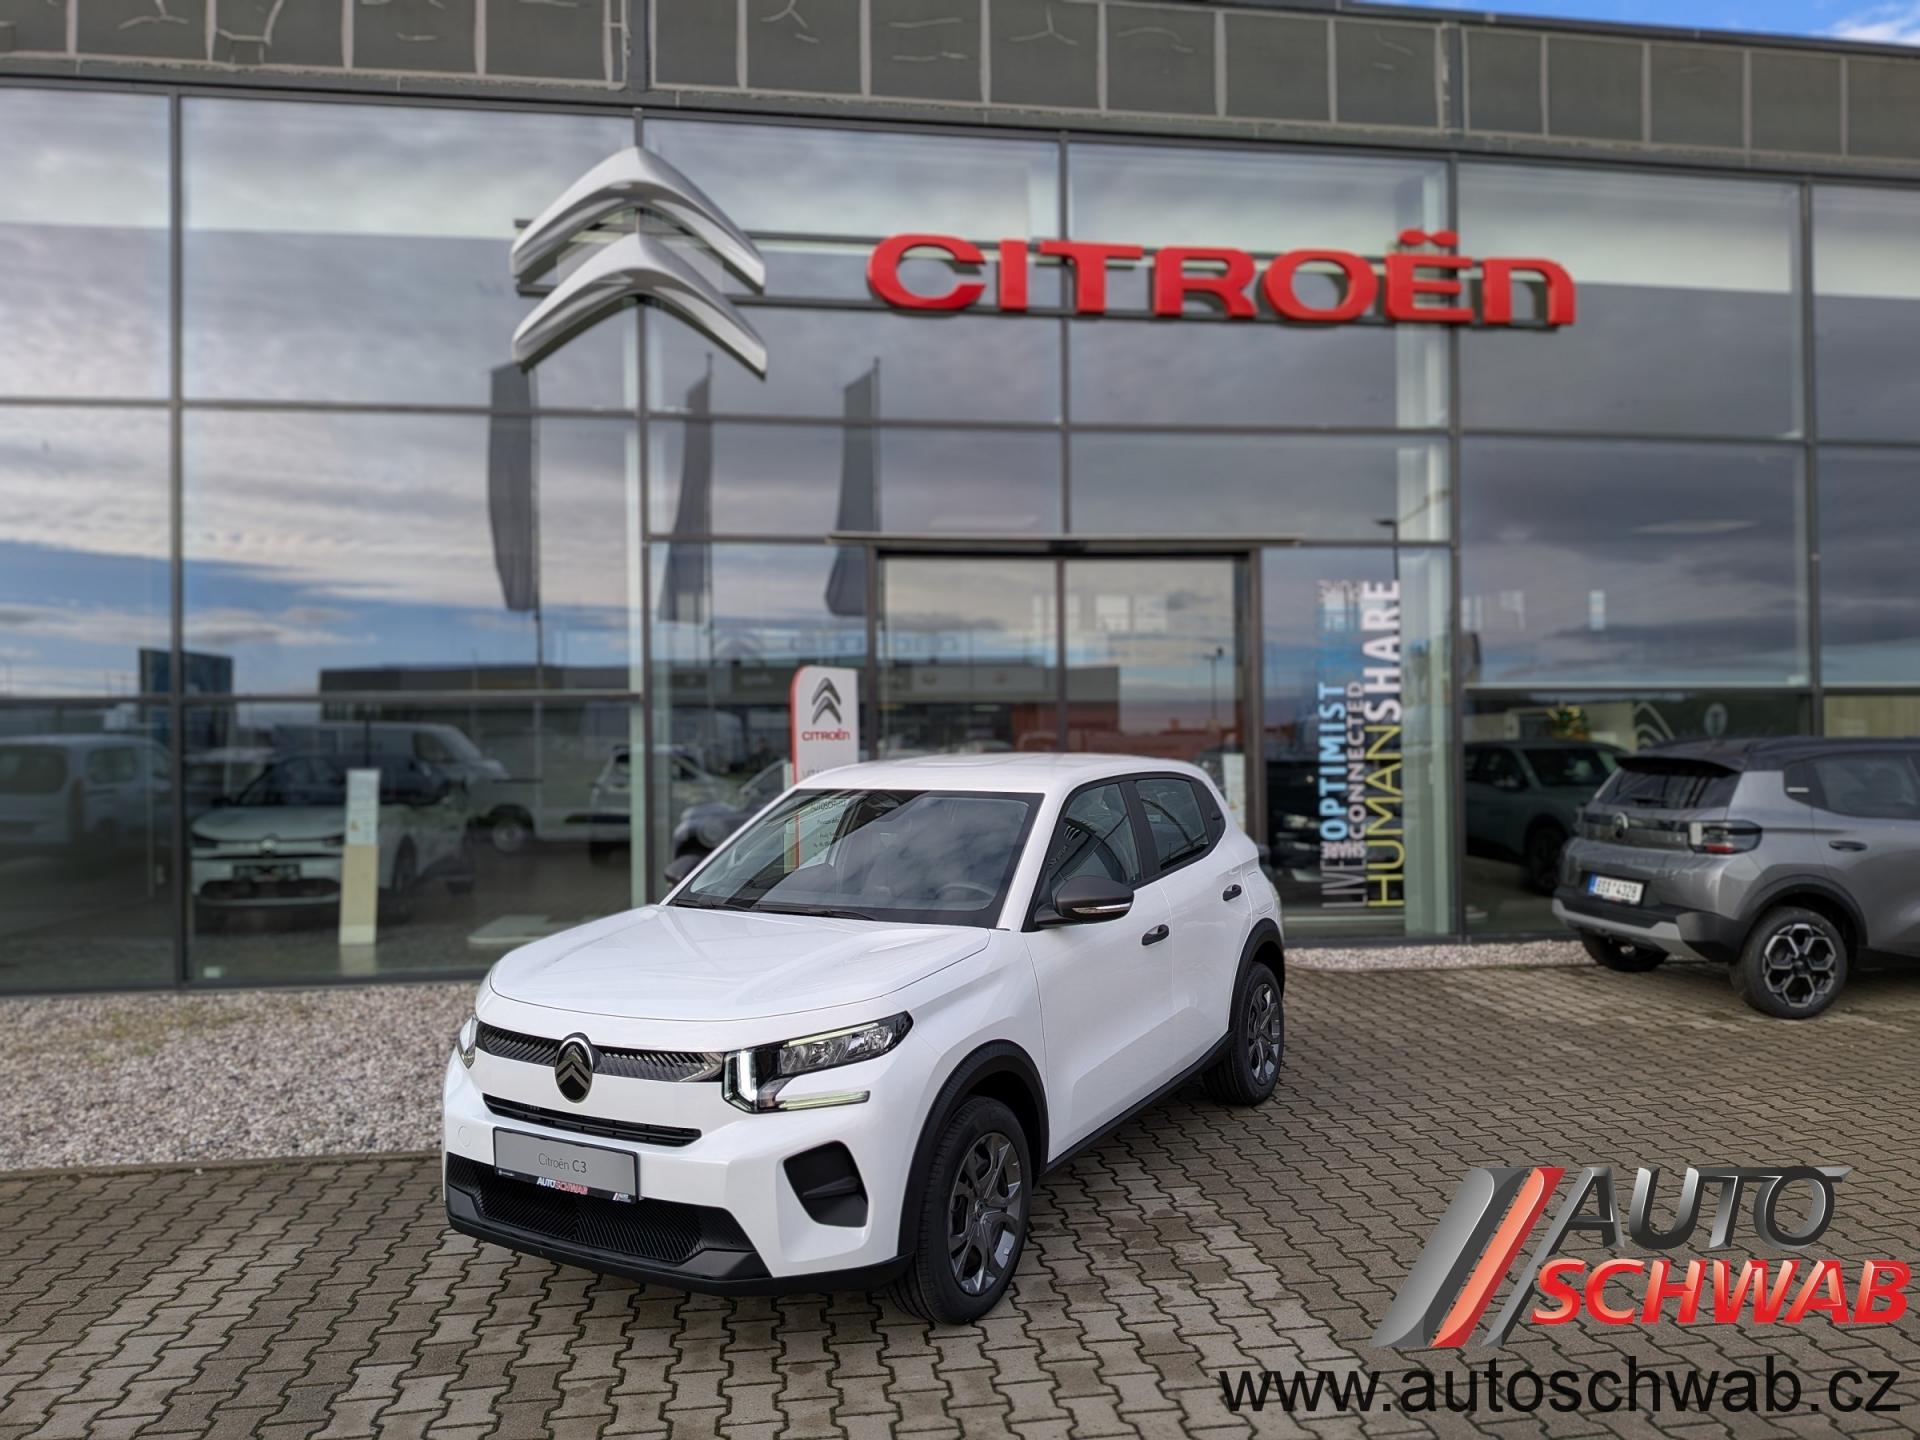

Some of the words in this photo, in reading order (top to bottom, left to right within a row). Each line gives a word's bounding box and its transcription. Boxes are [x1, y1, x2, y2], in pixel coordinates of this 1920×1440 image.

[1361, 580, 1400, 722] SHARE
[1318, 682, 1347, 840] OPTIMIST
[1346, 681, 1367, 840] CONNECTED
[1365, 725, 1405, 907] HUMAN
[1320, 859, 1367, 908] LIVE
[538, 1152, 570, 1170] Citroën
[572, 1160, 587, 1173] C3
